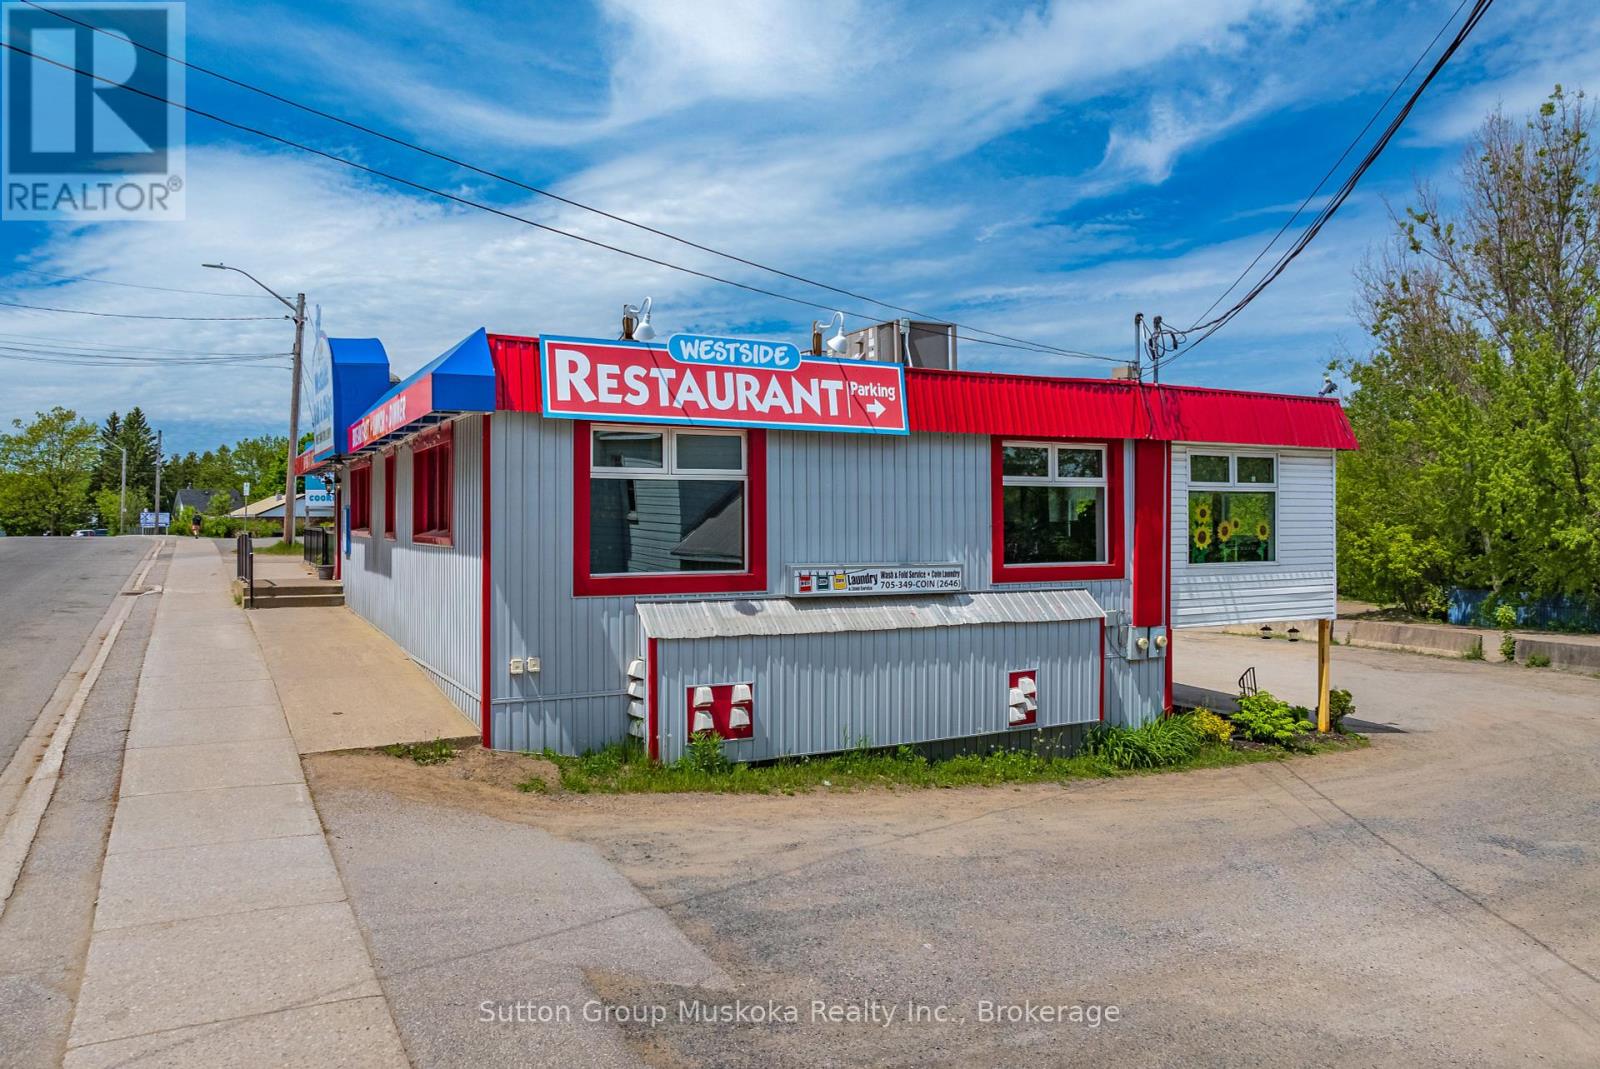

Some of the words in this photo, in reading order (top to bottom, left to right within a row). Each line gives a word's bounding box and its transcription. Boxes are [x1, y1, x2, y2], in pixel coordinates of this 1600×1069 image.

[680, 339, 791, 366] WESTSIDE
[850, 381, 896, 401] Parking
[848, 573, 878, 586] Laundry
[899, 571, 909, 579] Fold
[909, 571, 926, 579] Service
[942, 570, 960, 578] Laundry
[880, 580, 935, 589] 705-349-COIN
[937, 580, 961, 588] (2646)
